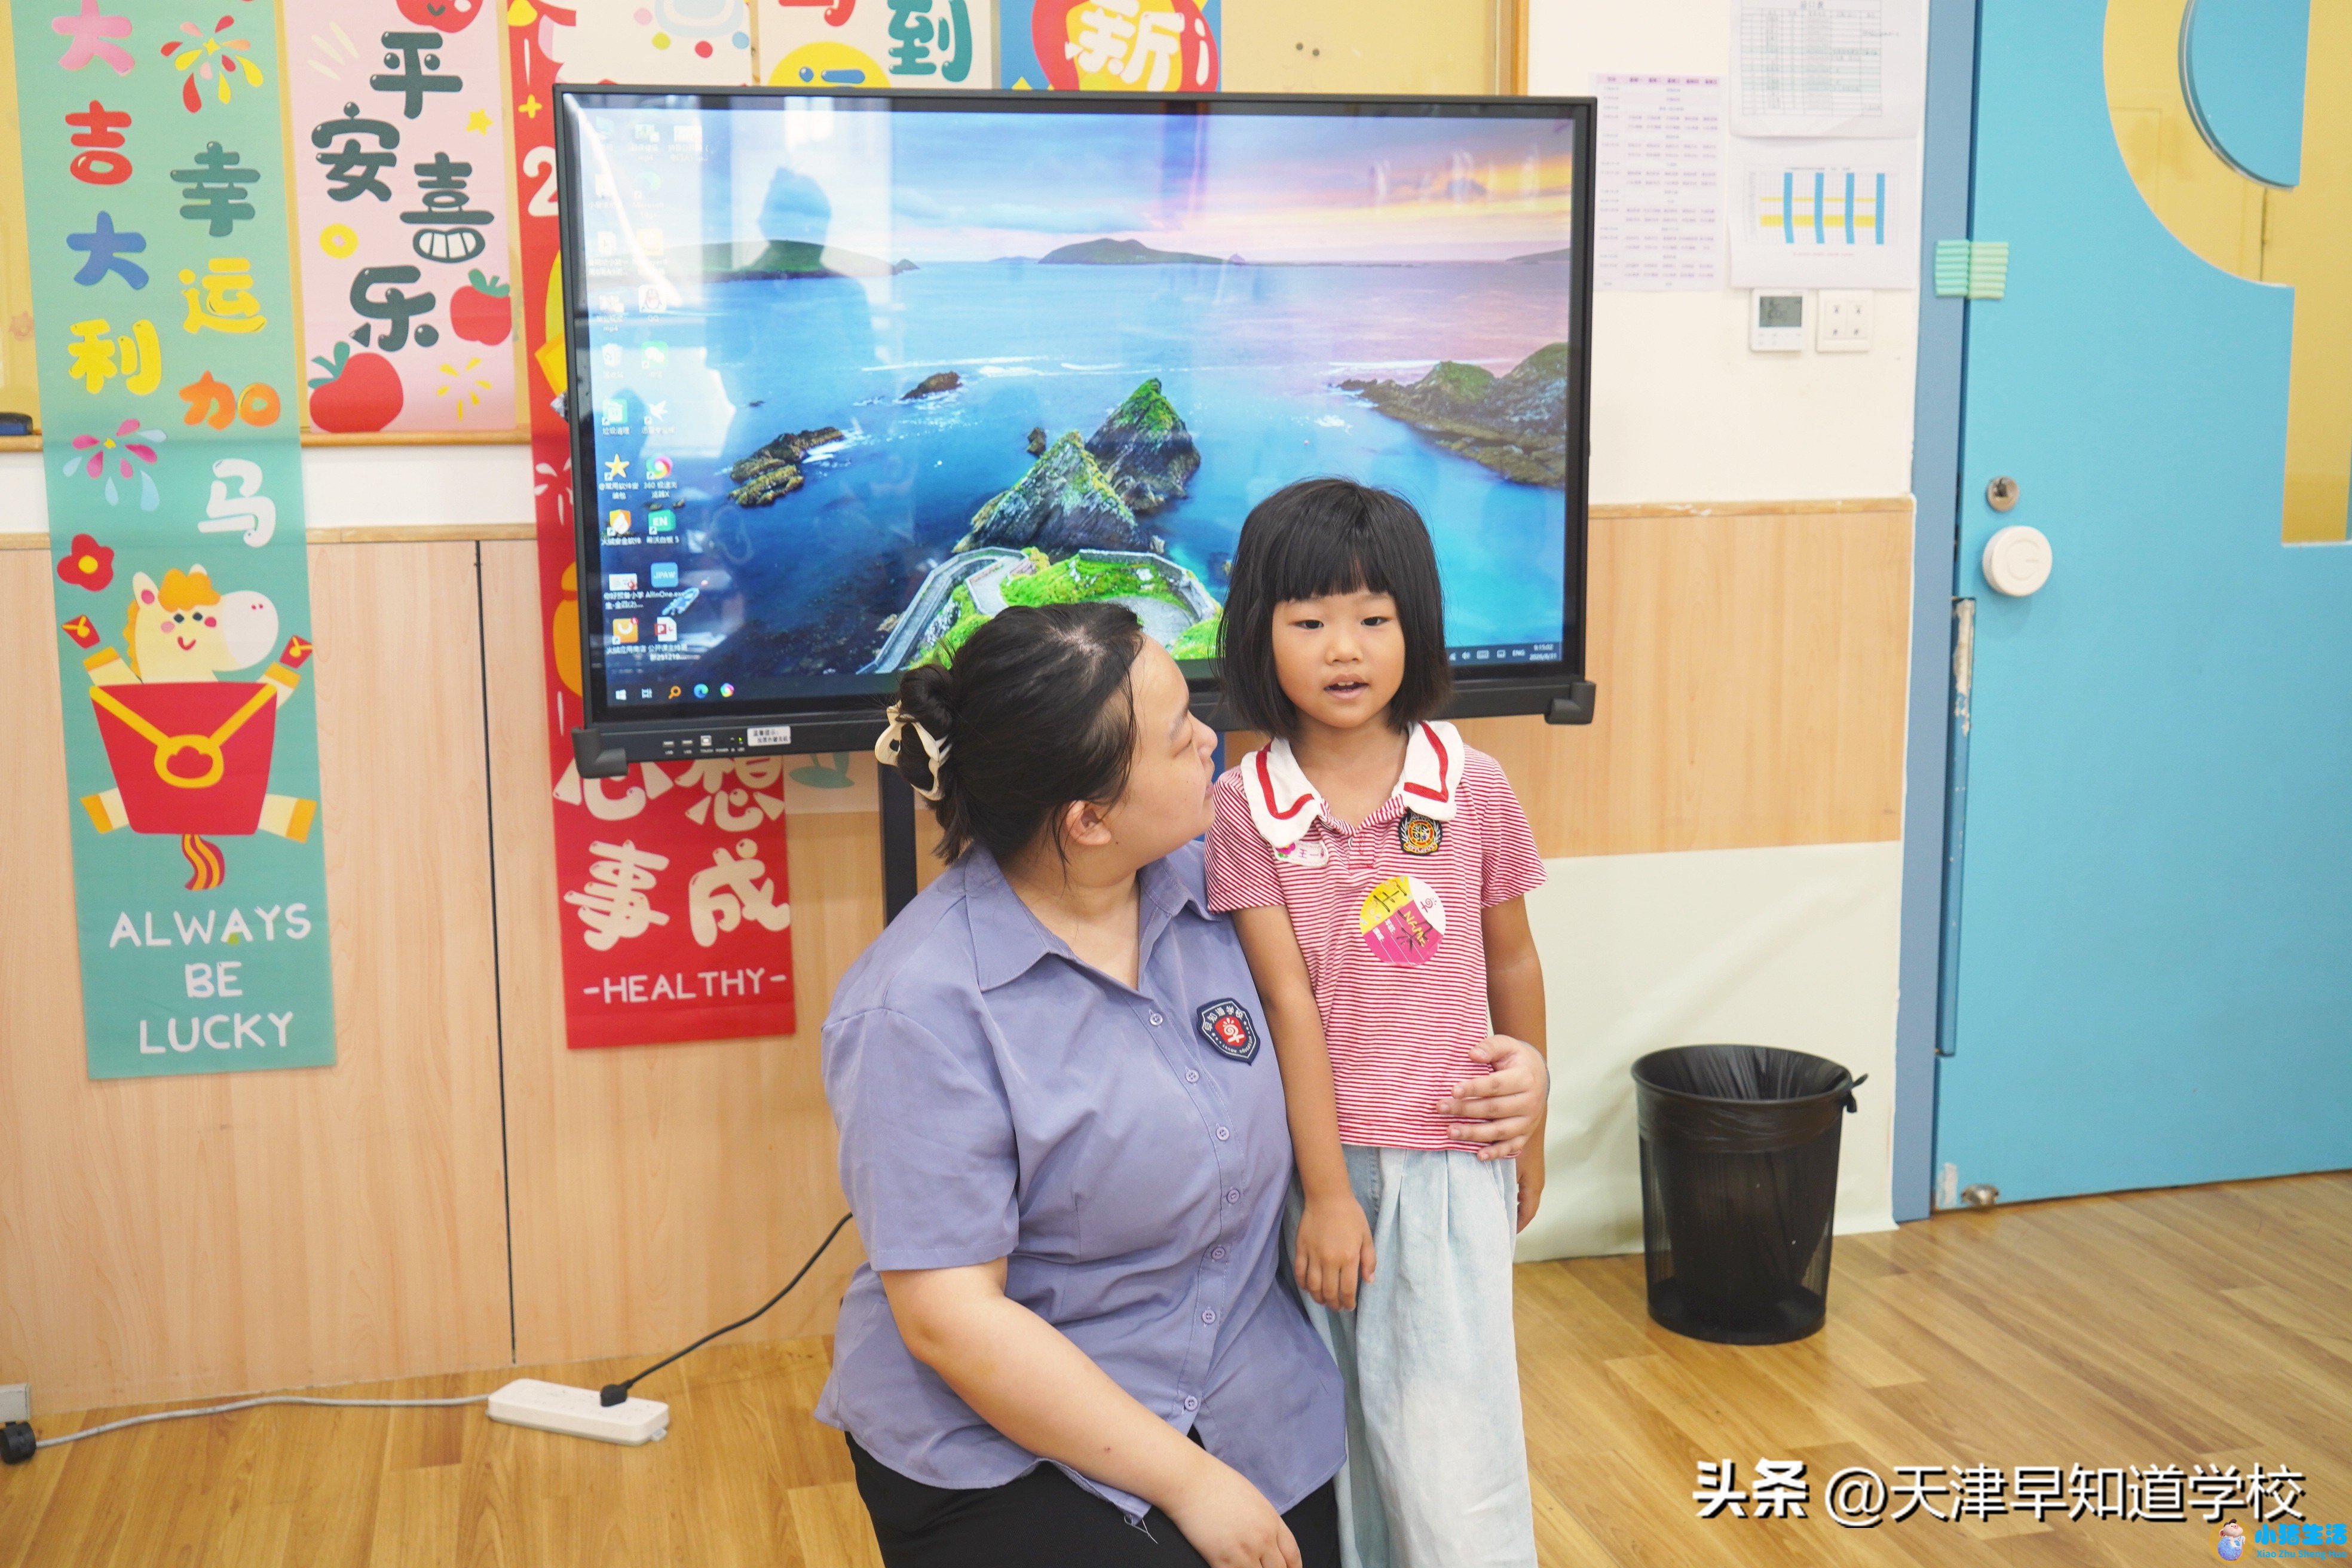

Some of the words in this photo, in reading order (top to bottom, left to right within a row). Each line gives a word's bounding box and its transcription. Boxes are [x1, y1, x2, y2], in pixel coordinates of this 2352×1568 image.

[652, 516, 668, 526] EN
[109, 903, 311, 948] ALWAYS
[185, 961, 243, 997] BE
[140, 1011, 293, 1054] LUCKY
